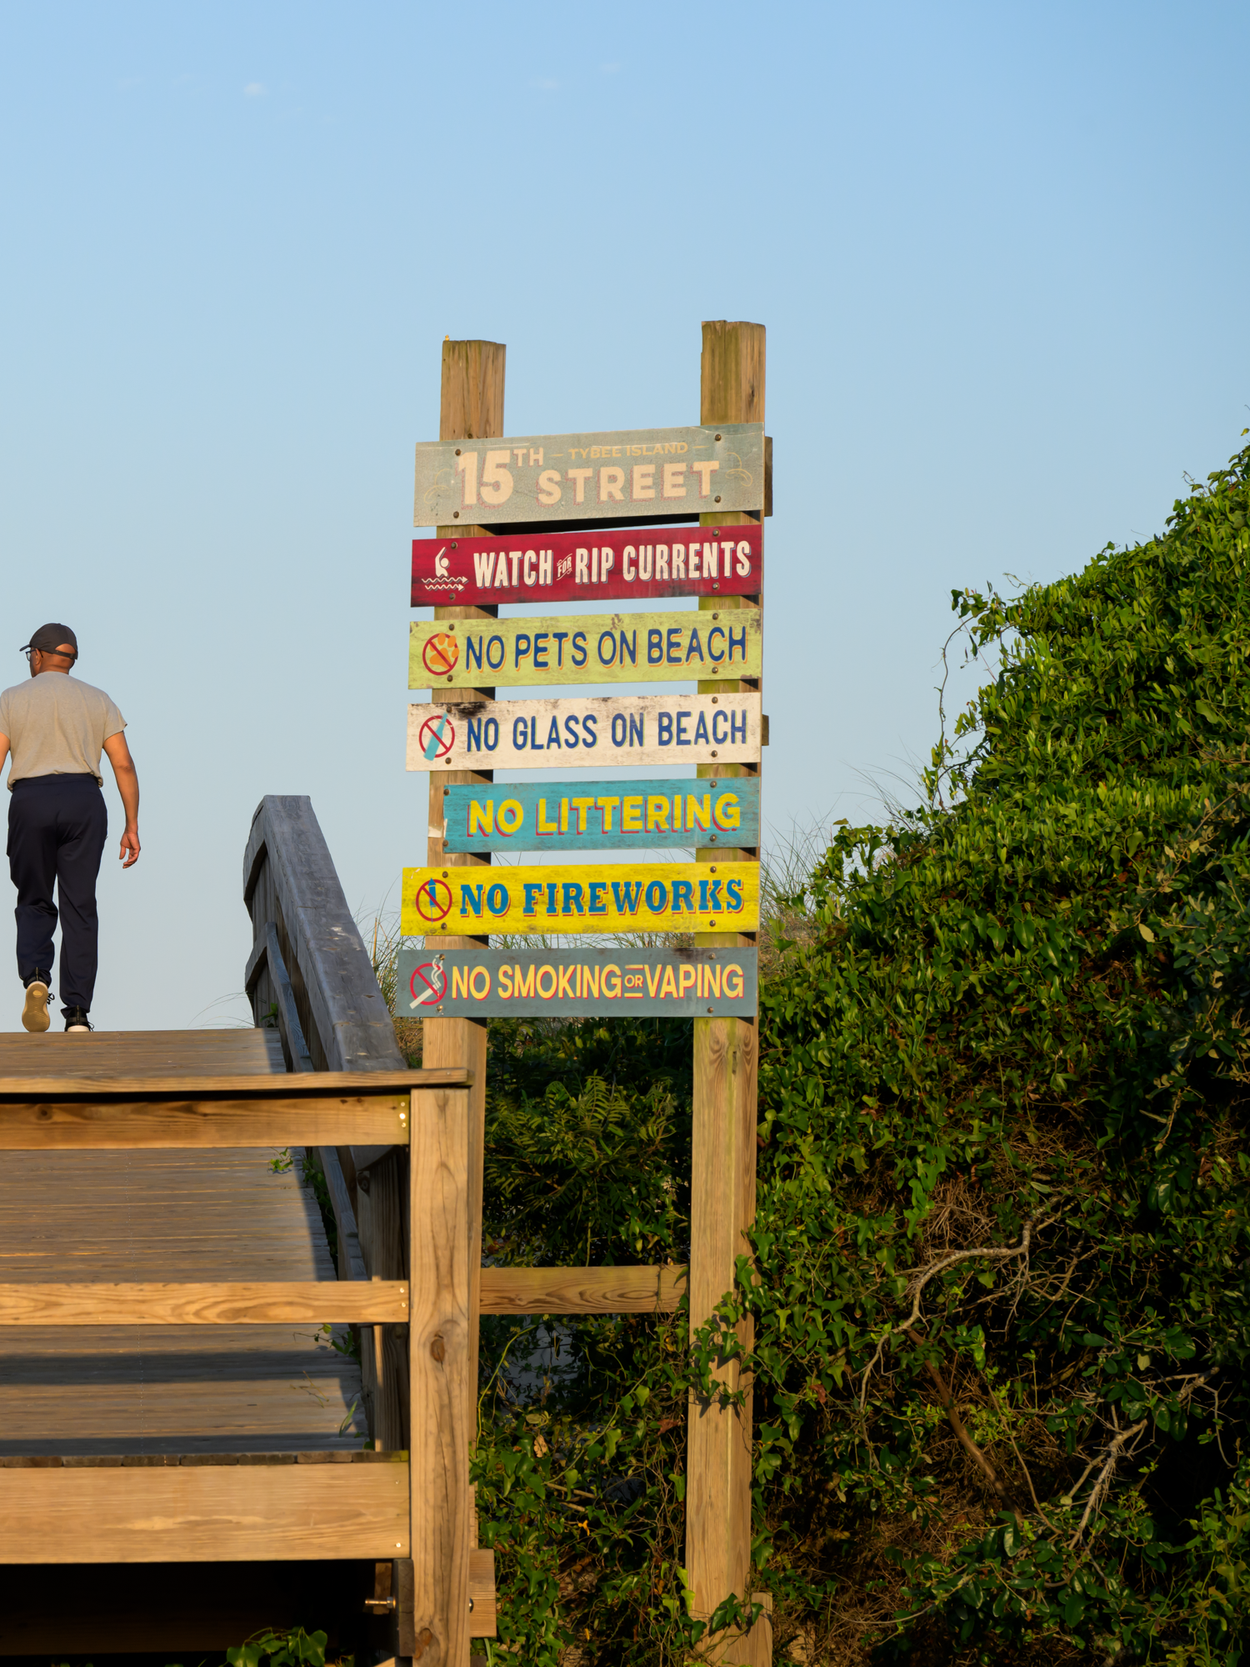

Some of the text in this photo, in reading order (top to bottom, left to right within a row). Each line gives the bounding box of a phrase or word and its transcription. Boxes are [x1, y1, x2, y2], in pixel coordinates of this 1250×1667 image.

[568, 442, 688, 460] TYBEE ISLAND
[537, 461, 720, 506] STREET
[473, 540, 751, 588] WATCH FOR RIP CURRENTS
[466, 626, 747, 671] NO PETS ON BEACH
[467, 709, 747, 752] NO GLASS ON BEACH
[467, 793, 741, 837] NO LITTERING
[460, 878, 744, 917] NO FIREWORKS
[452, 963, 744, 1000] NO SMOKING OR VAPING
